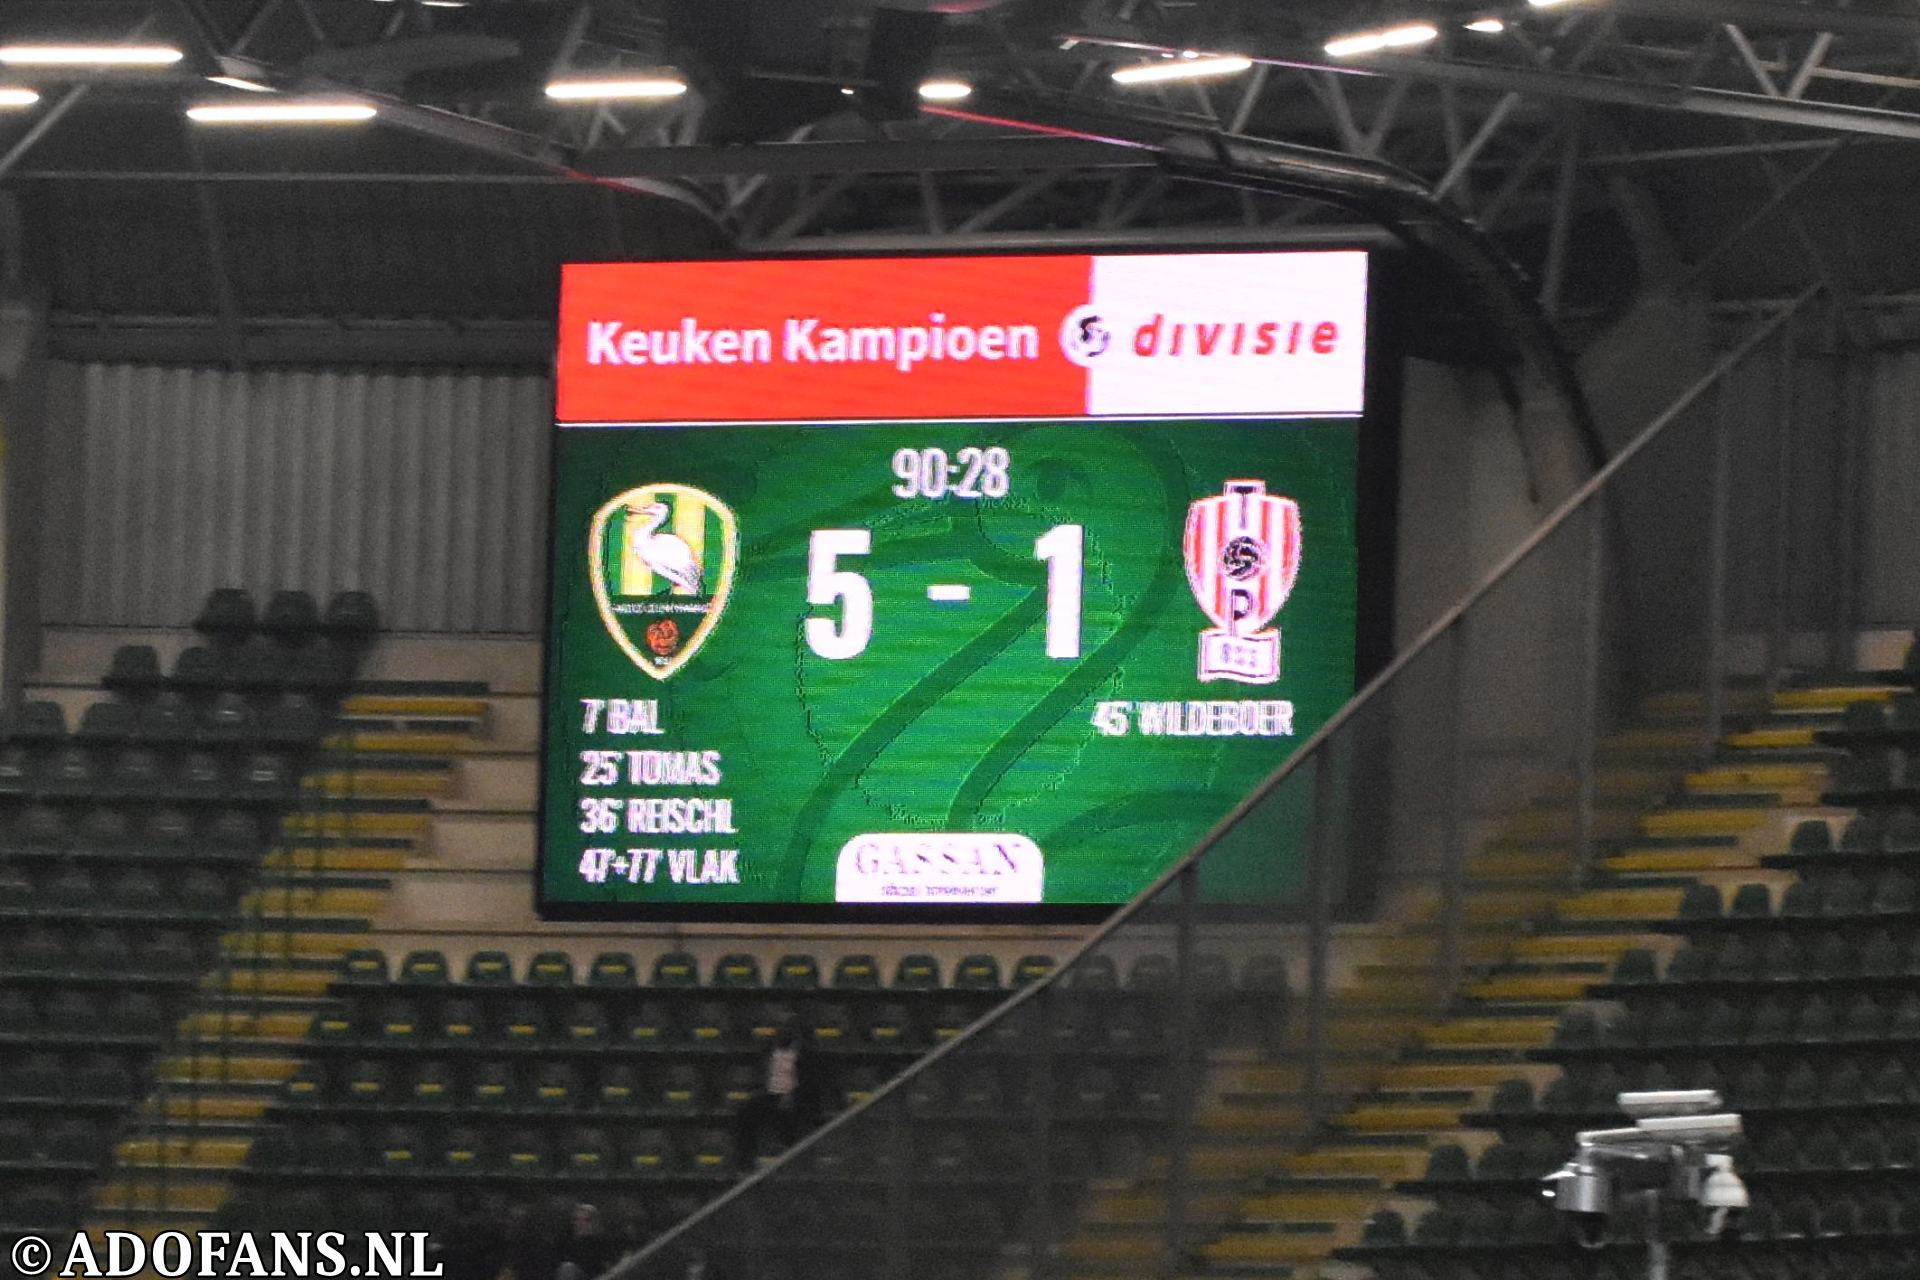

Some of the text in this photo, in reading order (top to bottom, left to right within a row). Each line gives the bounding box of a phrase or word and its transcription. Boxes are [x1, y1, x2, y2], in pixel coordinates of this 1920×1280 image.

[588, 312, 1338, 371] Keuken Kampioen divisie
[891, 447, 1011, 499] 90:28
[805, 529, 874, 660] 5
[1034, 524, 1084, 659] 1
[625, 750, 722, 785] TOMAS
[626, 798, 739, 833] REISCHL
[665, 848, 741, 884] VLAK
[855, 843, 1022, 875] GASSAN
